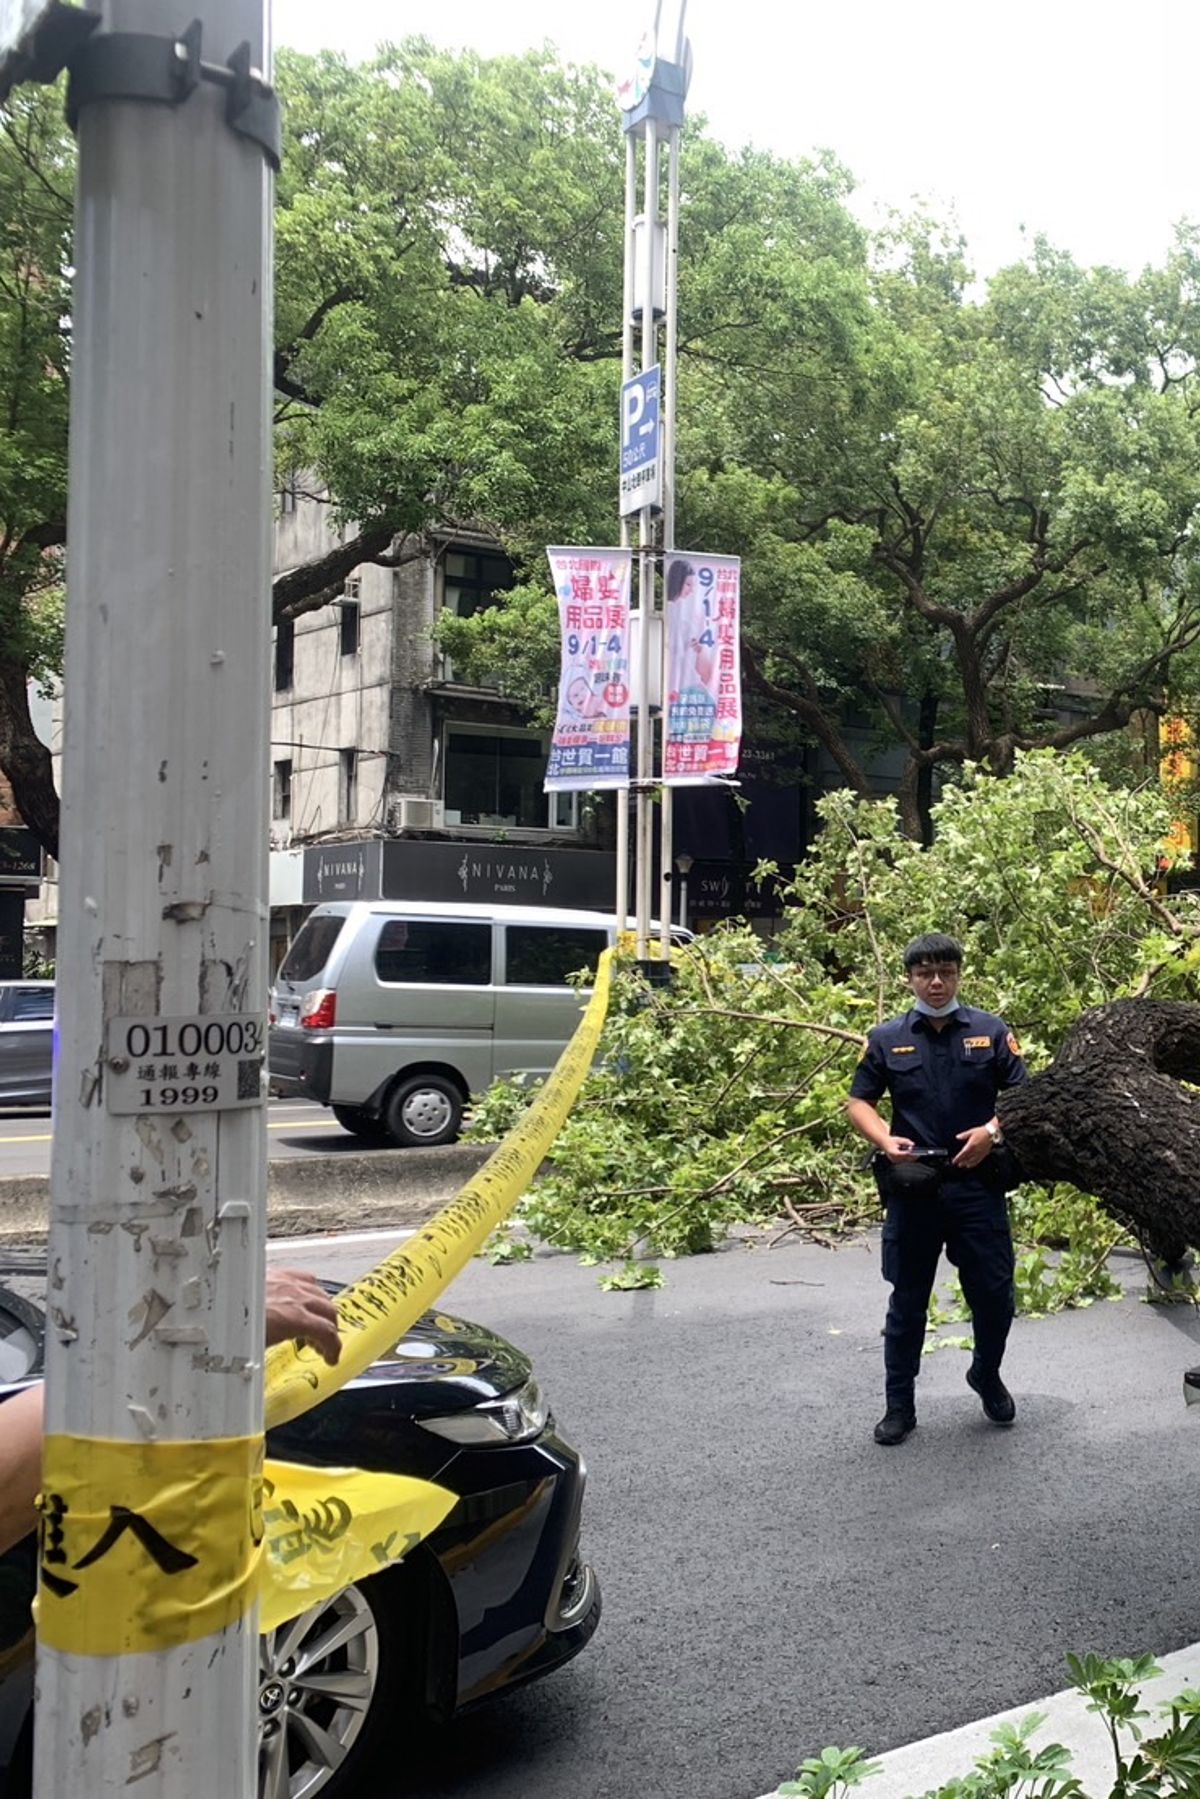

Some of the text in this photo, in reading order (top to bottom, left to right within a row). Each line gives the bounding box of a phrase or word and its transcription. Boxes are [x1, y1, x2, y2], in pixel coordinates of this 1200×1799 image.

[623, 383, 645, 449] P
[566, 604, 625, 630] 用品展
[568, 634, 622, 655] 9/1-4
[324, 861, 358, 876] NIVANA
[472, 862, 540, 881] NIVANA
[136, 1061, 222, 1082] 通報專線
[139, 1085, 219, 1107] 1999
